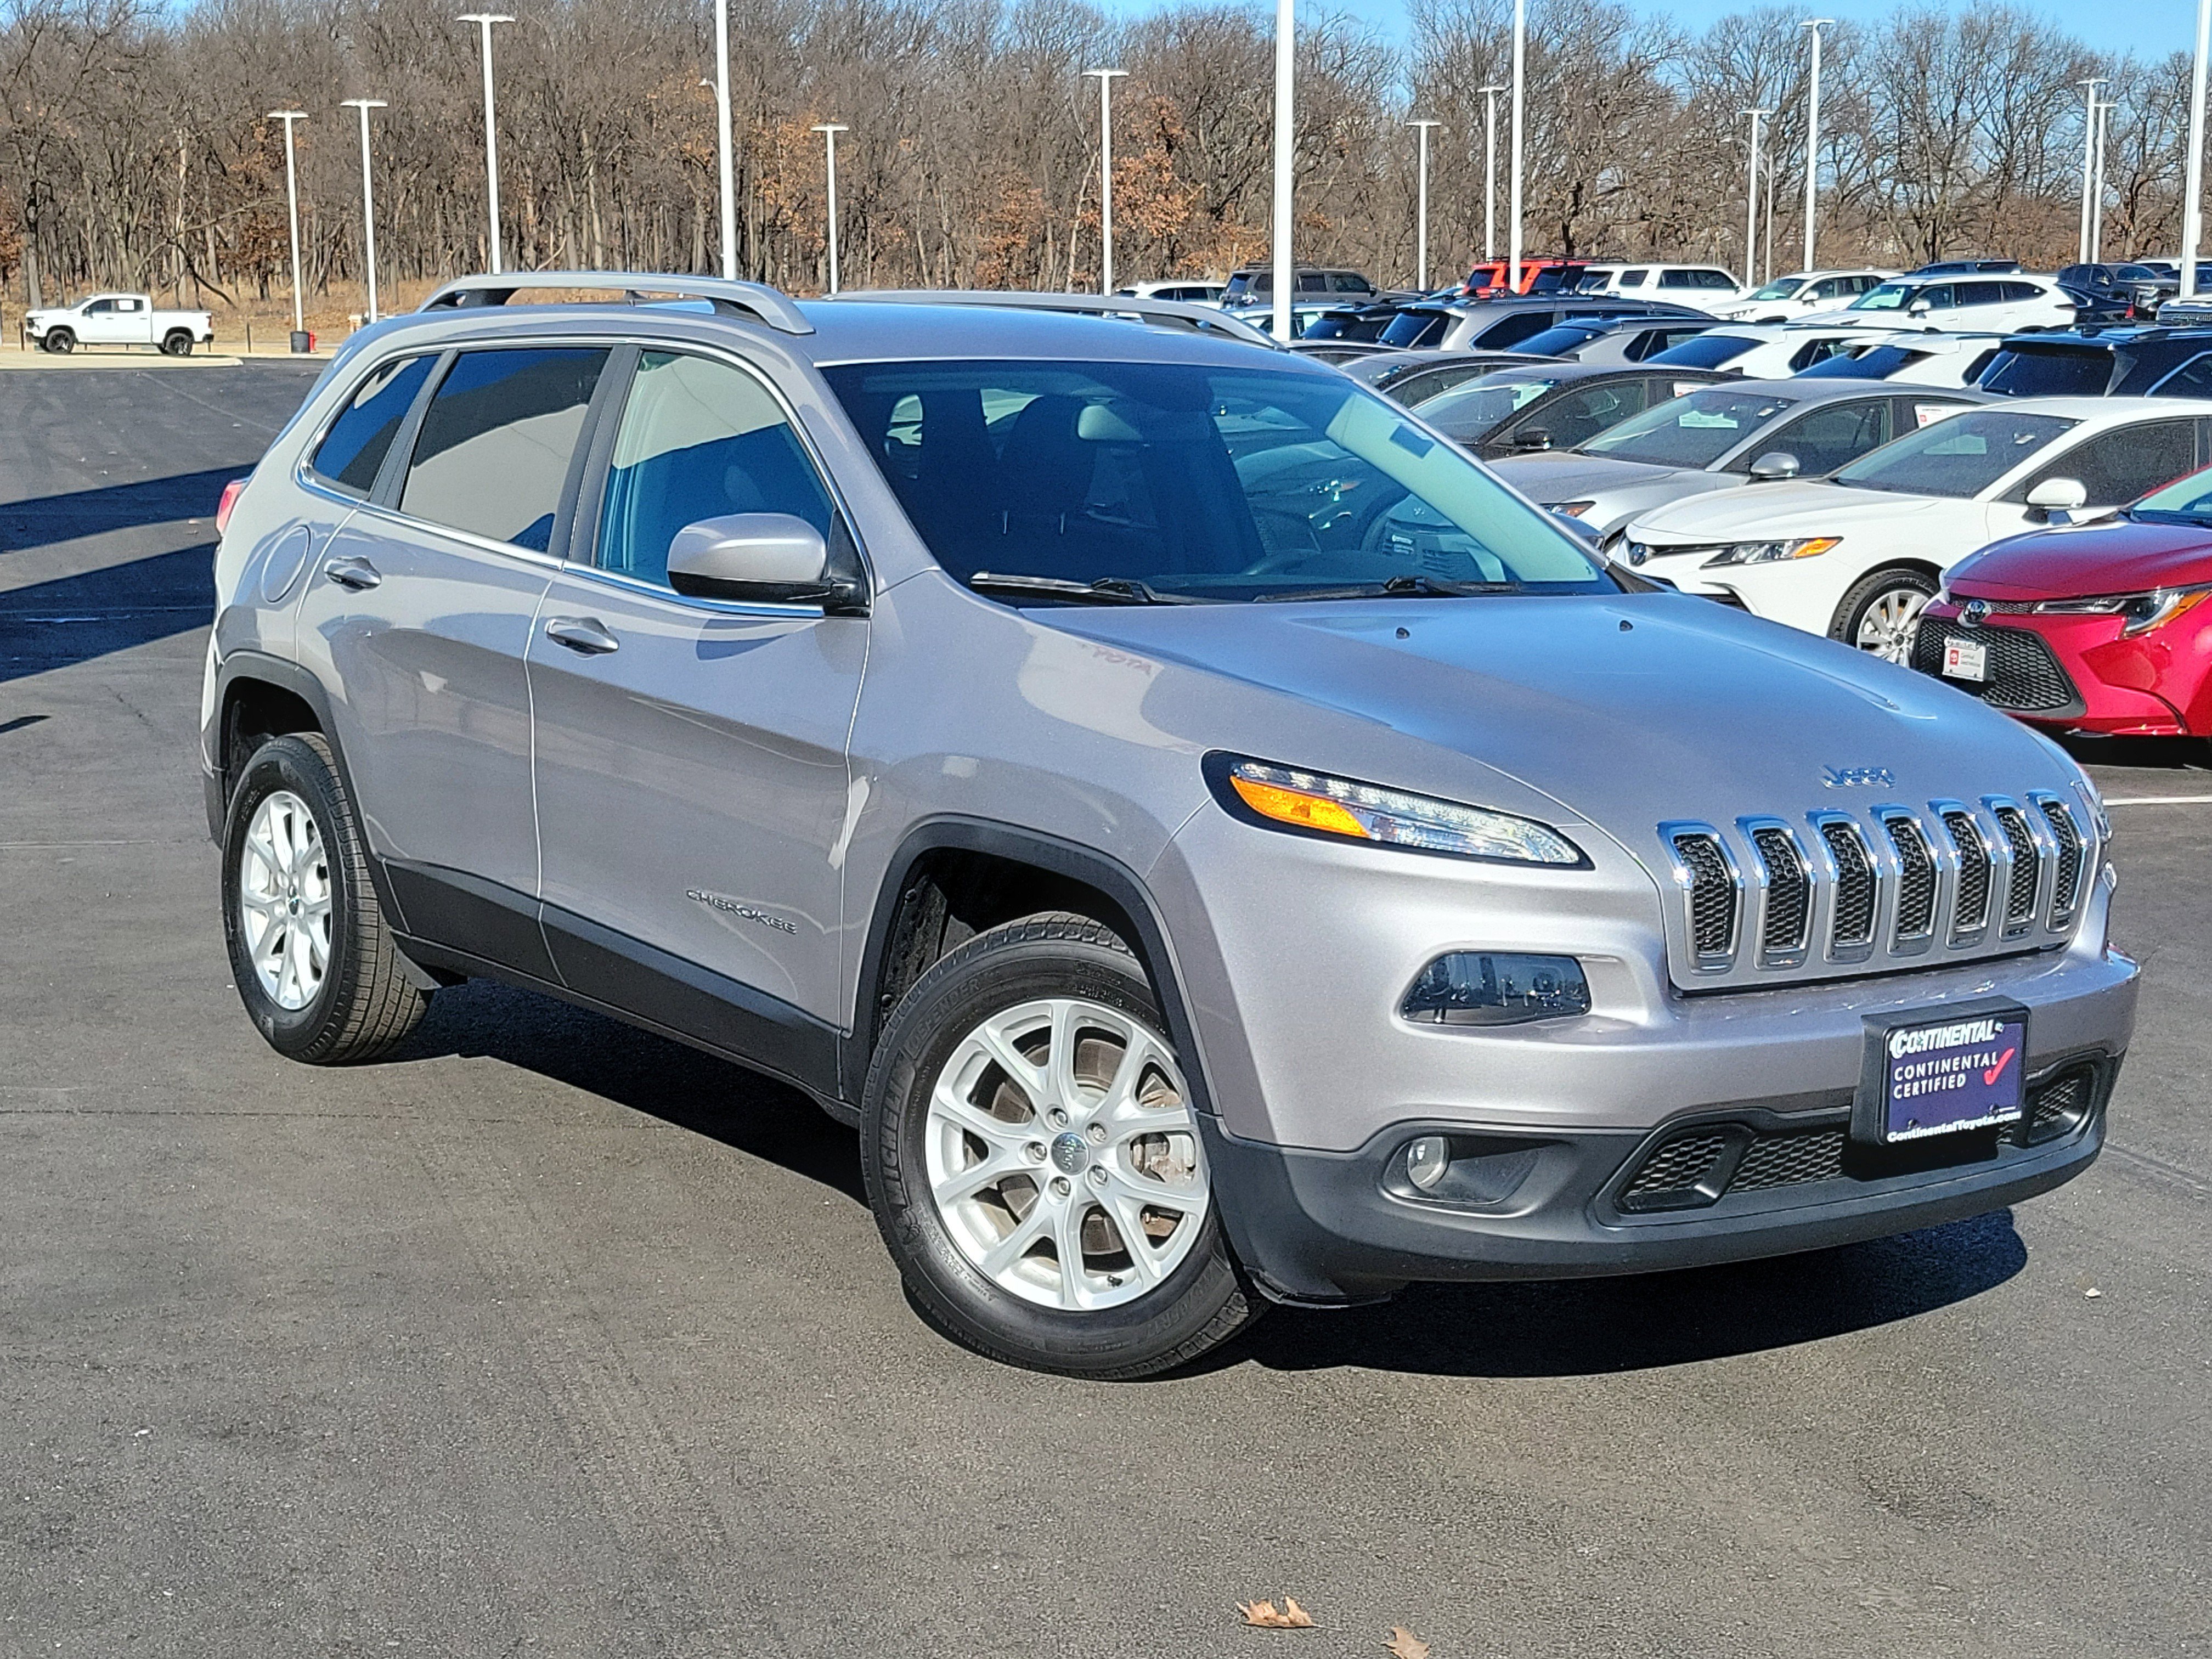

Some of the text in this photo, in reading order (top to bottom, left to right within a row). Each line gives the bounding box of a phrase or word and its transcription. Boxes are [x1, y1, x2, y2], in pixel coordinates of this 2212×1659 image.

[1818, 764, 1896, 789] Jeep
[686, 889, 797, 935] CHEROKEE
[1889, 1019, 1995, 1059] CONTINENTAL
[1894, 1052, 1998, 1081] CONTINENTAL
[1893, 1073, 1966, 1099] CERTIFIED
[880, 1052, 909, 1206] MICHELI
[1887, 1110, 2022, 1142] ContinentalToyota.com
